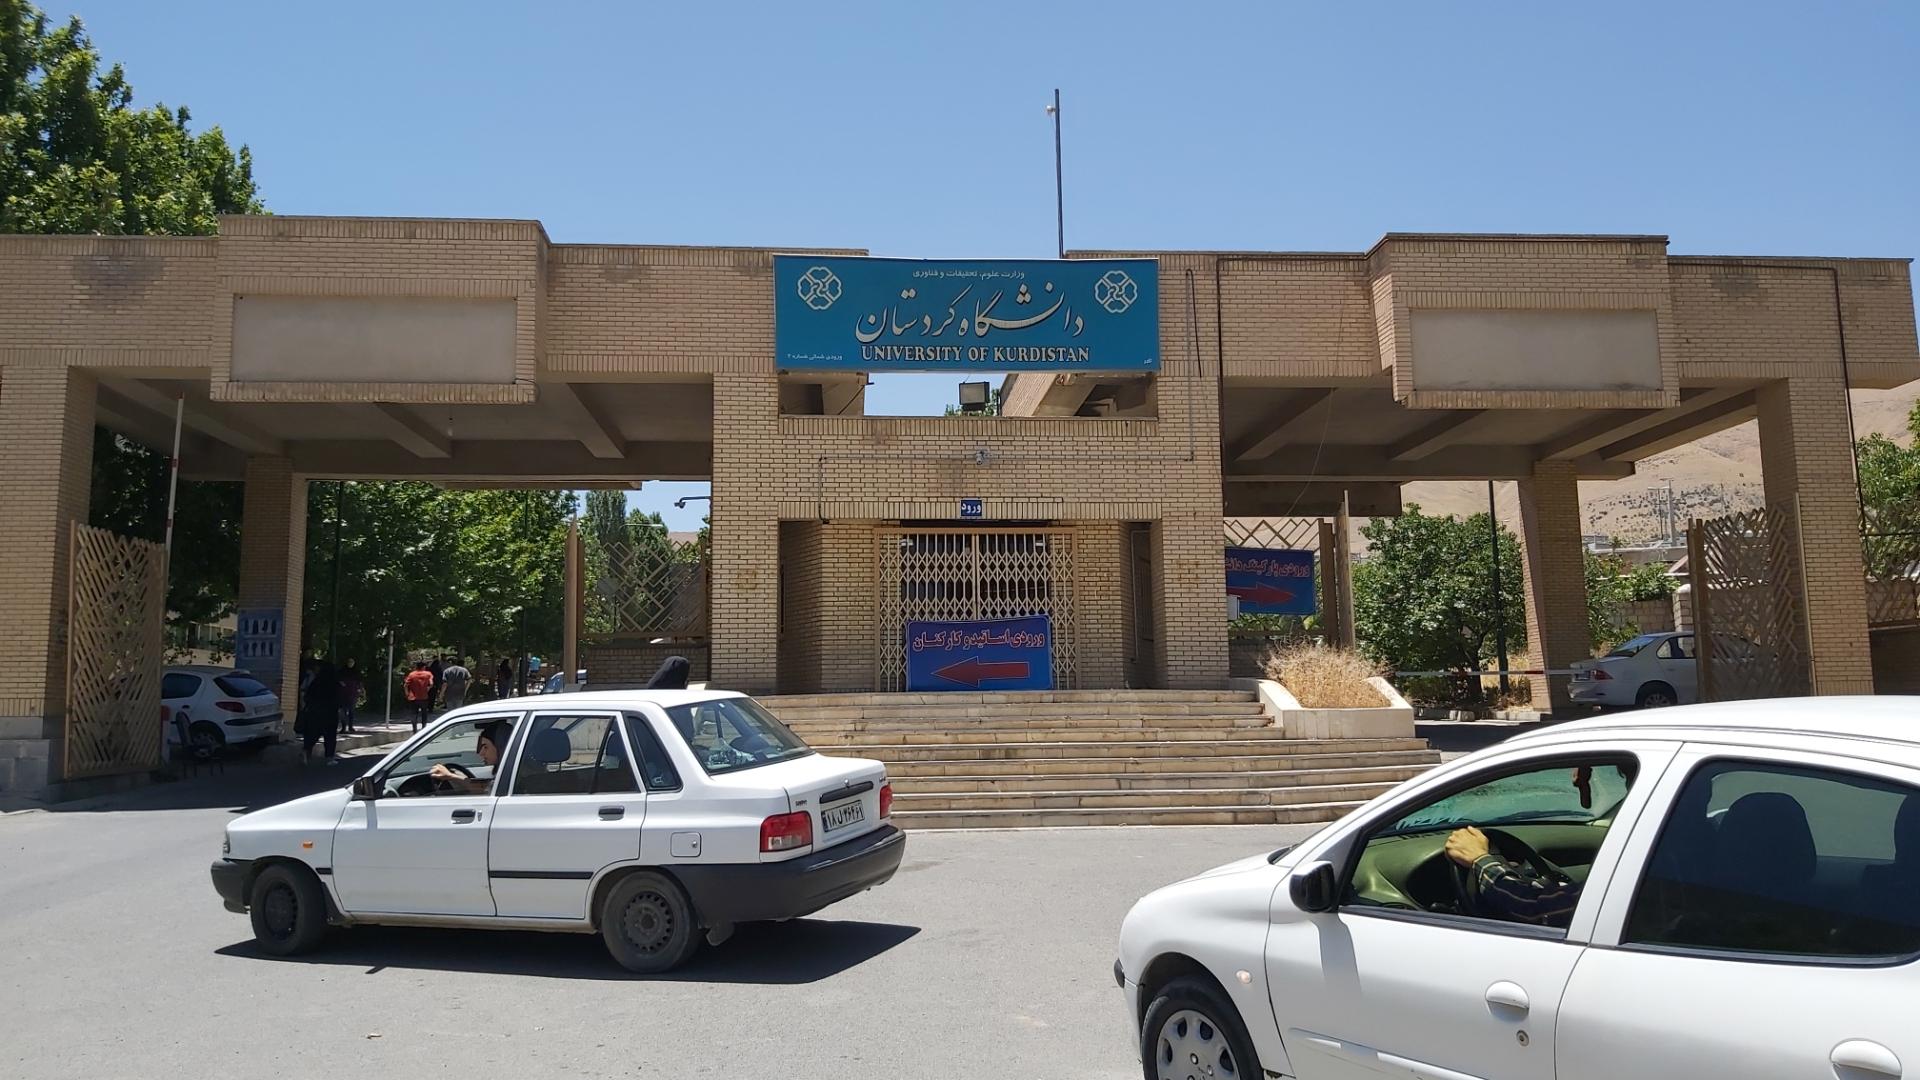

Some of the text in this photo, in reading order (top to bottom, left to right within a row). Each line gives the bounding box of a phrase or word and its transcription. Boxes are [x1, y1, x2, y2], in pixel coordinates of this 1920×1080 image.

[912, 269, 939, 279] فناوری
[946, 269, 978, 278] تحقیقات
[1001, 269, 1025, 280] وزارت
[855, 282, 1084, 344] دانشگاه کردستان
[861, 345, 1090, 363] UNIVERSITY OF KURDISTAN
[961, 502, 982, 514] ورود
[1279, 563, 1310, 578] ورودی
[913, 630, 963, 652] کارکنان
[970, 628, 1010, 649] اساتید
[1010, 630, 1046, 648] ورودی
